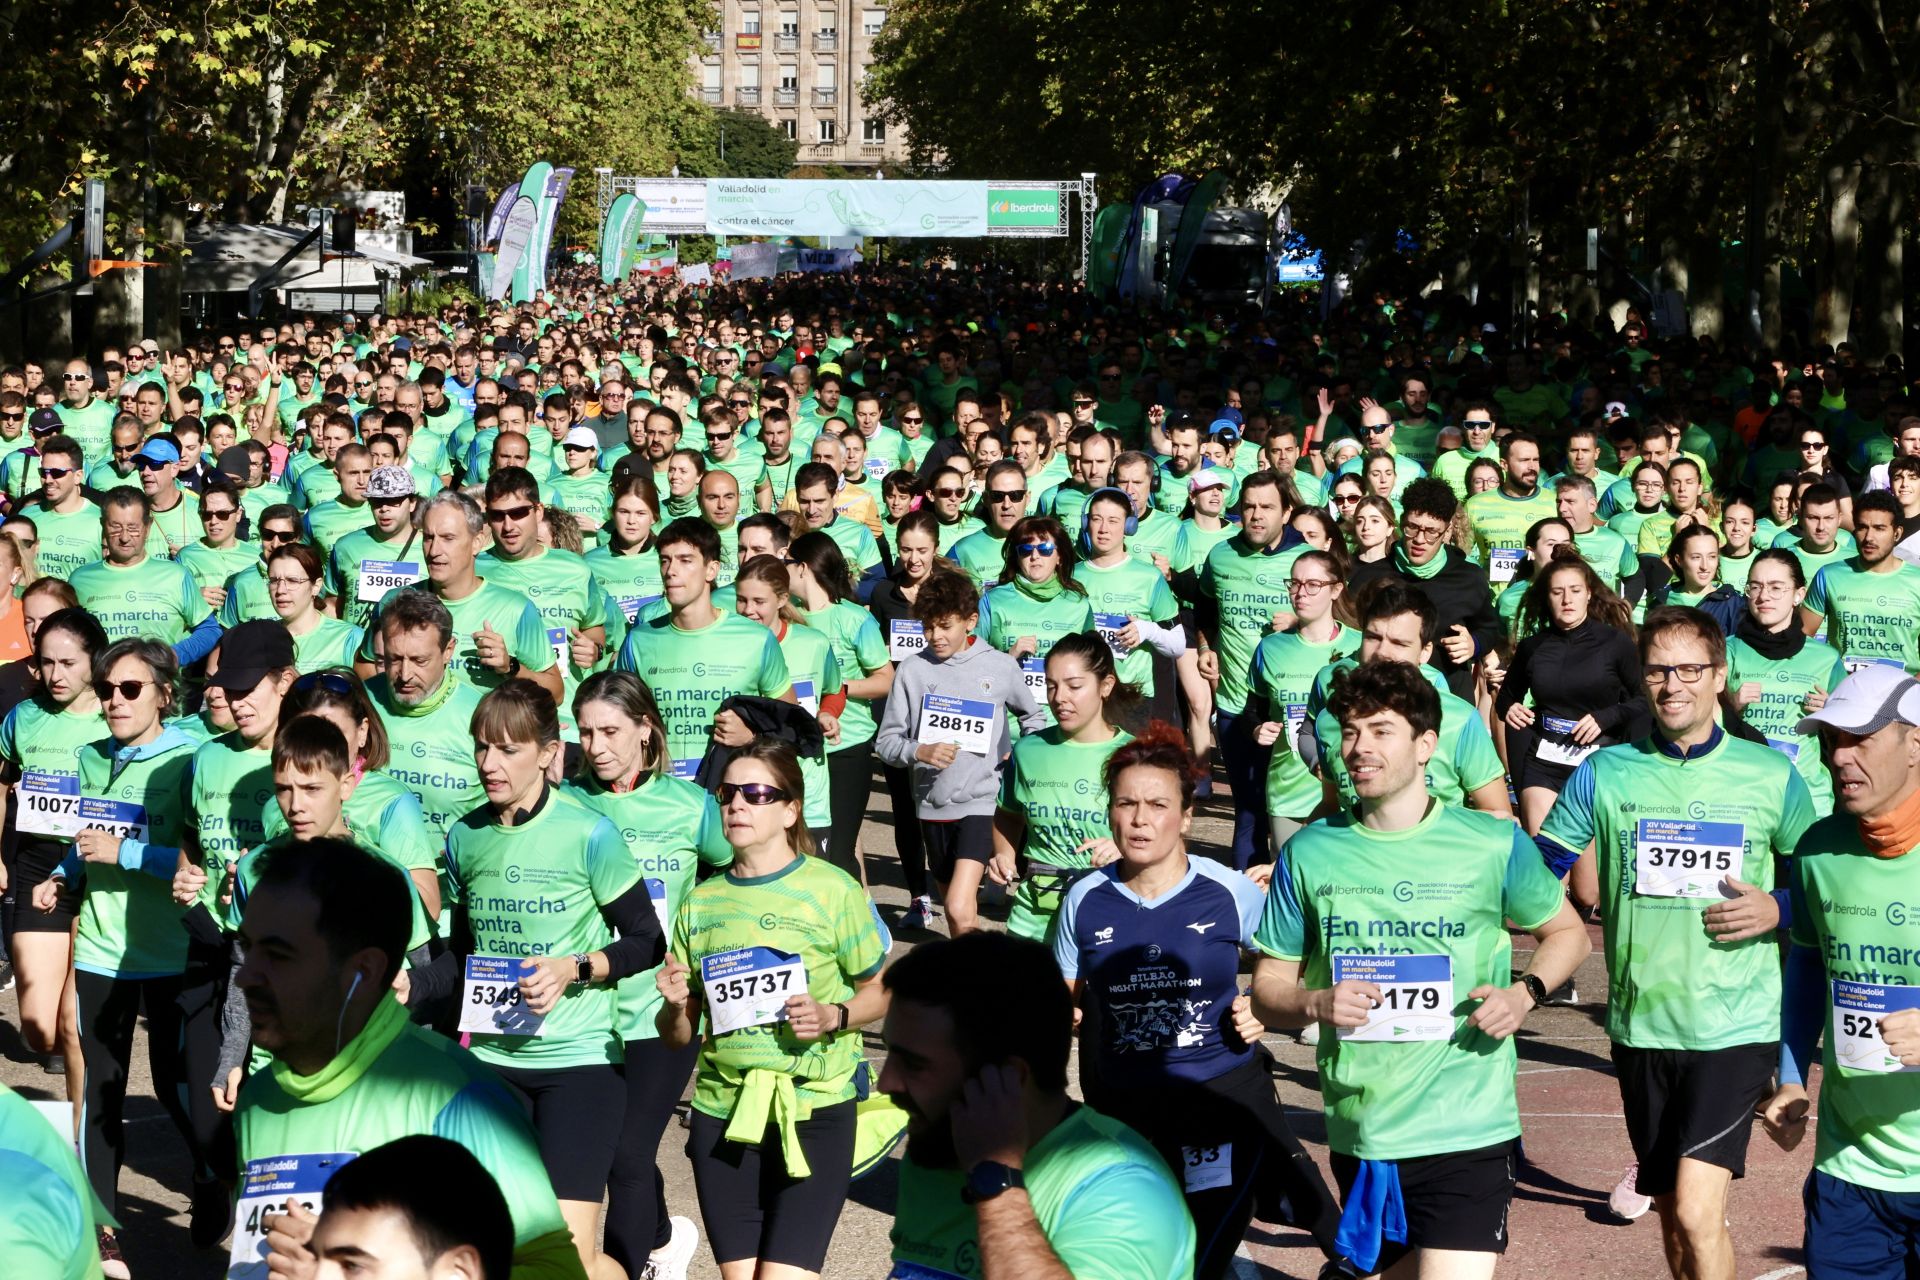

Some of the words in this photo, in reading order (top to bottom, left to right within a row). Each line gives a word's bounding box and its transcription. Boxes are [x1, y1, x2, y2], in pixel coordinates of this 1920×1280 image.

[718, 185, 766, 194] Valladolid
[768, 186, 781, 194] en
[717, 195, 754, 203] marcha
[1010, 202, 1055, 213] Iberdrola
[717, 217, 748, 225] contra
[750, 217, 760, 225] el
[762, 217, 795, 225] cáncer
[43, 552, 86, 565] marcha
[1495, 560, 1518, 570] 430
[1224, 590, 1239, 602] En
[1242, 592, 1292, 605] march
[118, 608, 168, 621] marcha
[538, 607, 574, 618] archa
[1224, 606, 1268, 617] contra
[1843, 611, 1859, 623] En
[1863, 613, 1913, 628] marcha
[104, 623, 139, 636] ontra
[1845, 625, 1886, 638] contra
[896, 636, 929, 648] 288
[1859, 639, 1904, 652] cáncer
[658, 665, 688, 674] Iberdrola
[655, 686, 674, 701] En
[1279, 689, 1298, 702] En
[660, 705, 706, 719] contra
[929, 713, 985, 734] 28815
[35, 745, 69, 755] Iberdrola
[36, 775, 60, 784] Valladolid
[388, 767, 468, 792] marcha
[1036, 779, 1069, 789] Iberdrola
[215, 790, 248, 800] Iberdrola
[1028, 801, 1046, 818] En
[1053, 802, 1110, 826] march
[1637, 804, 1680, 815] Iberdrola
[203, 816, 224, 831] En
[1646, 820, 1659, 829] XIV
[1659, 821, 1696, 831] Valladolid
[1674, 835, 1695, 843] cáncer
[636, 854, 680, 872] rcha
[1620, 829, 1629, 896] VALLADOLID
[1648, 846, 1731, 871] 37915
[1334, 884, 1384, 896] Iberdrola
[470, 892, 484, 910] En
[489, 895, 567, 914] marcha
[1833, 904, 1877, 917] Iberdrola
[1329, 915, 1361, 937] En
[1368, 915, 1466, 938] marcha
[488, 935, 554, 956] cáncer
[1828, 936, 1852, 960] En
[1859, 943, 1920, 966] marc
[481, 960, 509, 968] Valladolid
[708, 957, 718, 966] XIV
[719, 951, 753, 964] Valladolid
[1341, 959, 1355, 967] XIV
[1356, 959, 1396, 967] Valladolid
[708, 969, 726, 978] contra
[734, 963, 754, 973] cáncer
[716, 961, 738, 970] marcha
[1130, 970, 1176, 984] BILBAO
[1372, 973, 1396, 981] cáncer
[715, 970, 792, 1004] 35737
[1109, 983, 1138, 993] NIGHT
[1141, 977, 1202, 990] MARATHON
[1838, 983, 1848, 992] XIV
[1849, 985, 1885, 996] Valladolid
[472, 985, 522, 1007] 5349
[1371, 987, 1440, 1010] 179
[1839, 998, 1857, 1006] contra
[1865, 1001, 1886, 1010] cáncer
[1843, 1013, 1873, 1039] 52
[1188, 1147, 1220, 1168] 33
[262, 1160, 298, 1173] Valladolid
[272, 1179, 296, 1191] cáncer
